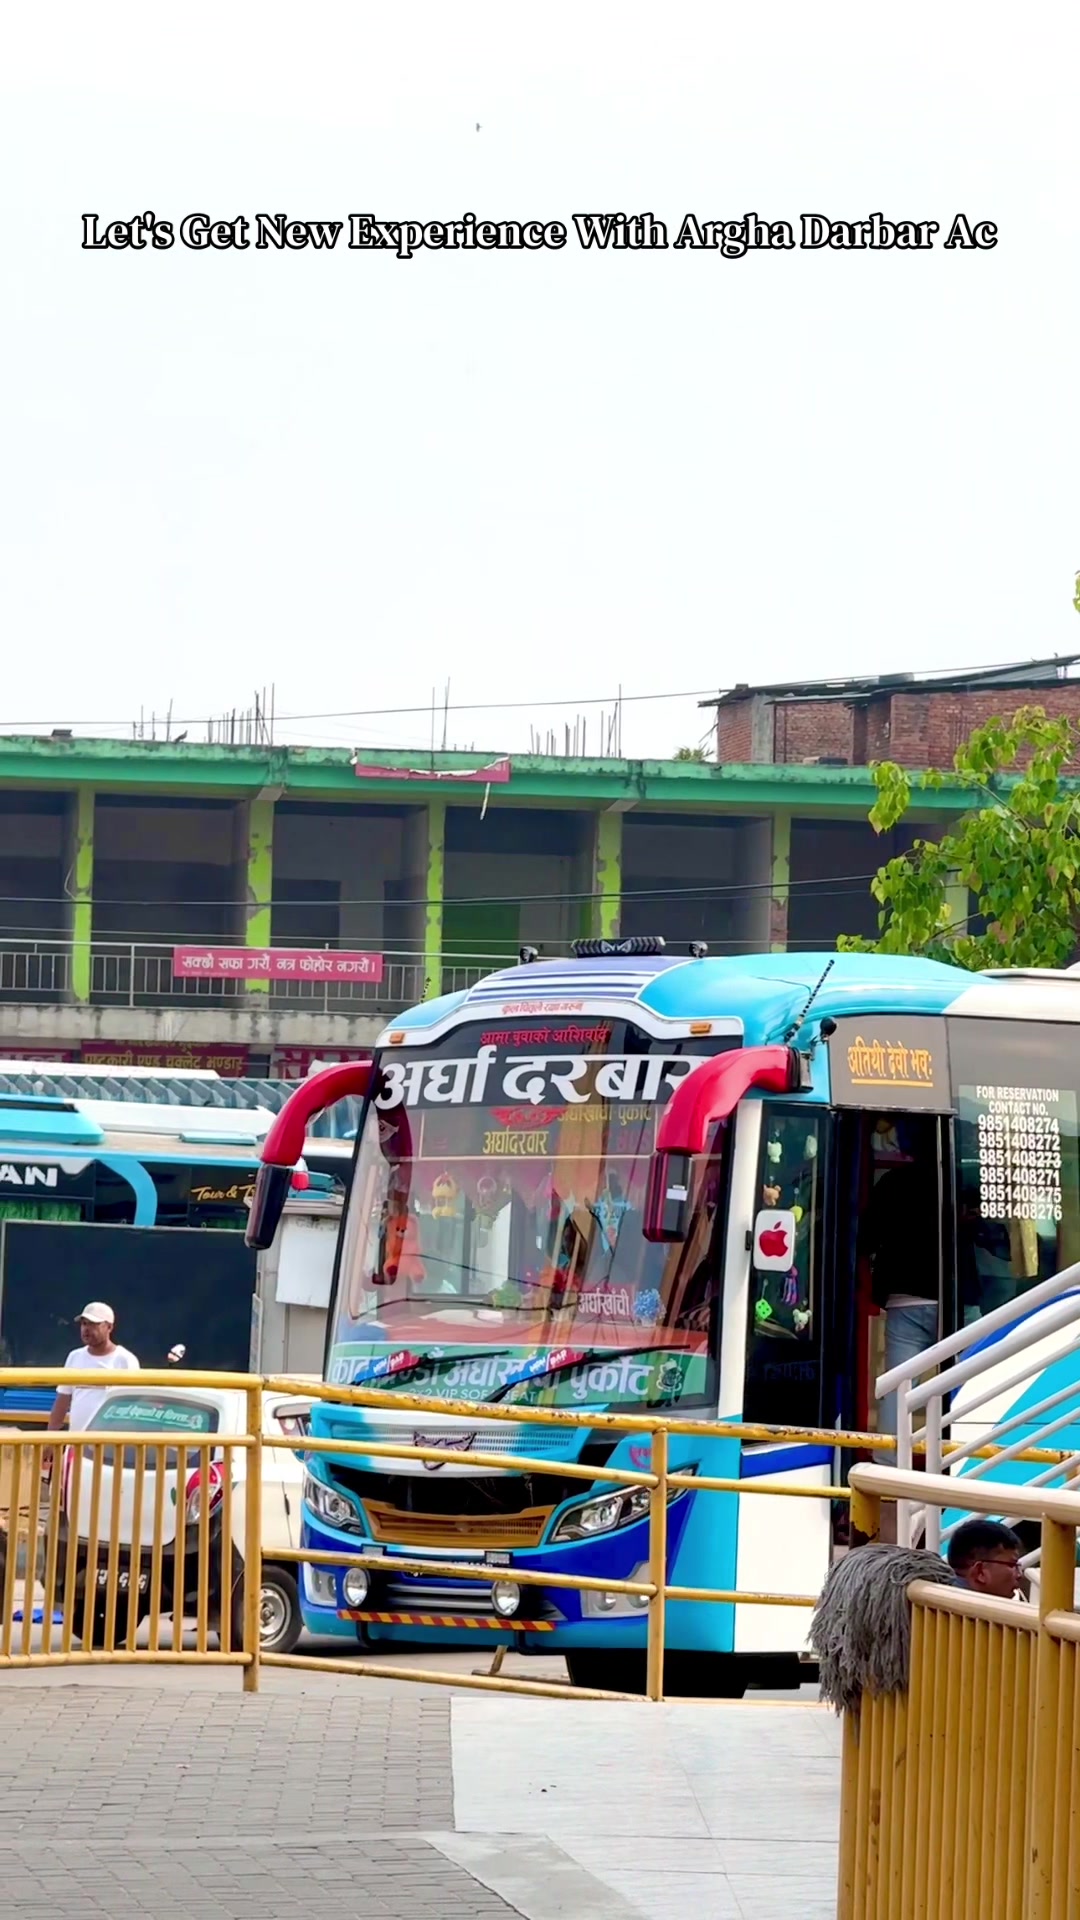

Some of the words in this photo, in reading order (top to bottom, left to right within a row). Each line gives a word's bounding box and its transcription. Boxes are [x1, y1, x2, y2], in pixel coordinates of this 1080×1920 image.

[218, 956, 243, 970] सफा
[277, 957, 296, 971] नत्र
[480, 1031, 511, 1045] आमा
[374, 1044, 498, 1110] अर्घा
[976, 1085, 996, 1099] FOR
[997, 1086, 1059, 1102] RESERVATION
[989, 1101, 1031, 1115] CONTACT
[1032, 1103, 1049, 1116] NO.
[978, 1114, 1059, 1134] 9851408274
[978, 1131, 1061, 1151] 9851408272
[979, 1167, 1060, 1187] 9851408271
[190, 1186, 225, 1201] Tour
[226, 1184, 238, 1198] &
[980, 1184, 1062, 1204] 9851408275
[980, 1202, 1063, 1221] 9851408276
[436, 1388, 459, 1399] VIP
[459, 1388, 493, 1400] SOF
